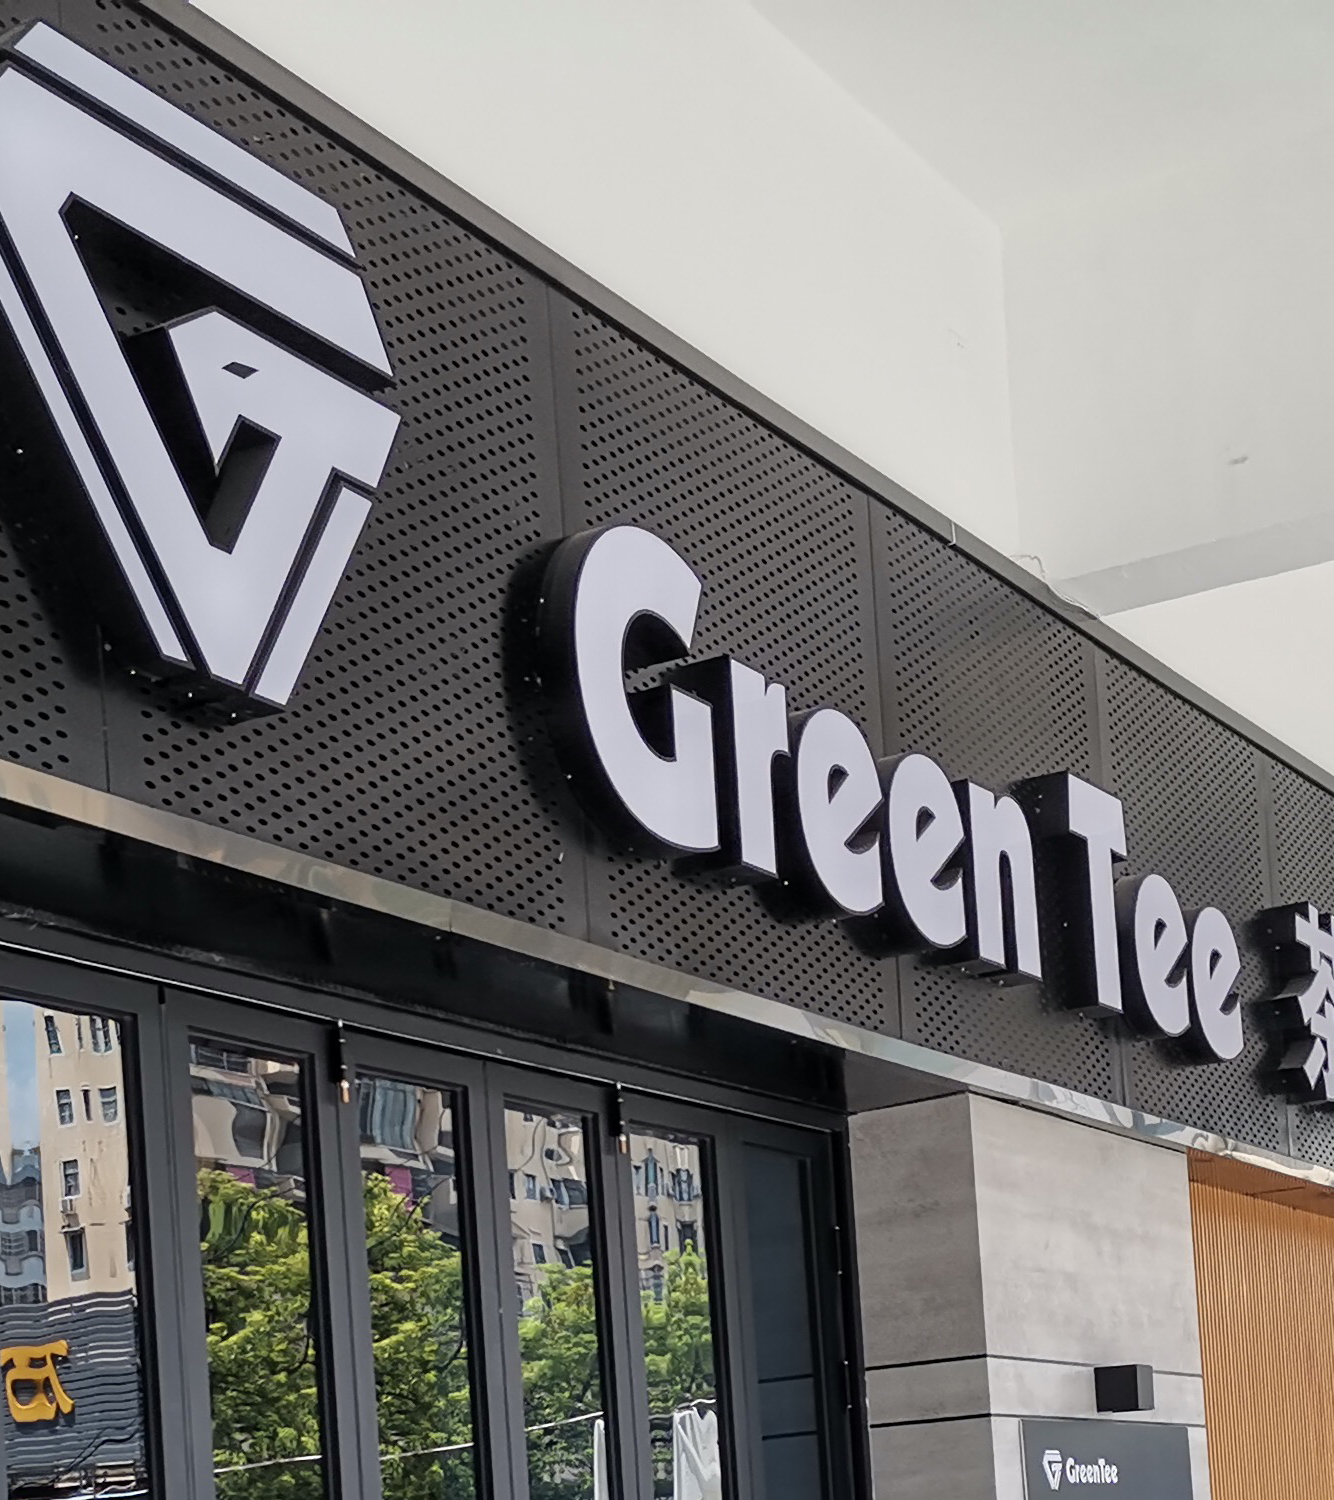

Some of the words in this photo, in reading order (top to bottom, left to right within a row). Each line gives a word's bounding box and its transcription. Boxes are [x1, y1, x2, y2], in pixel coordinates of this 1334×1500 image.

[574, 524, 1044, 983] Green
[1067, 772, 1245, 1061] Tee
[1066, 1457, 1119, 1484] GreenTee
